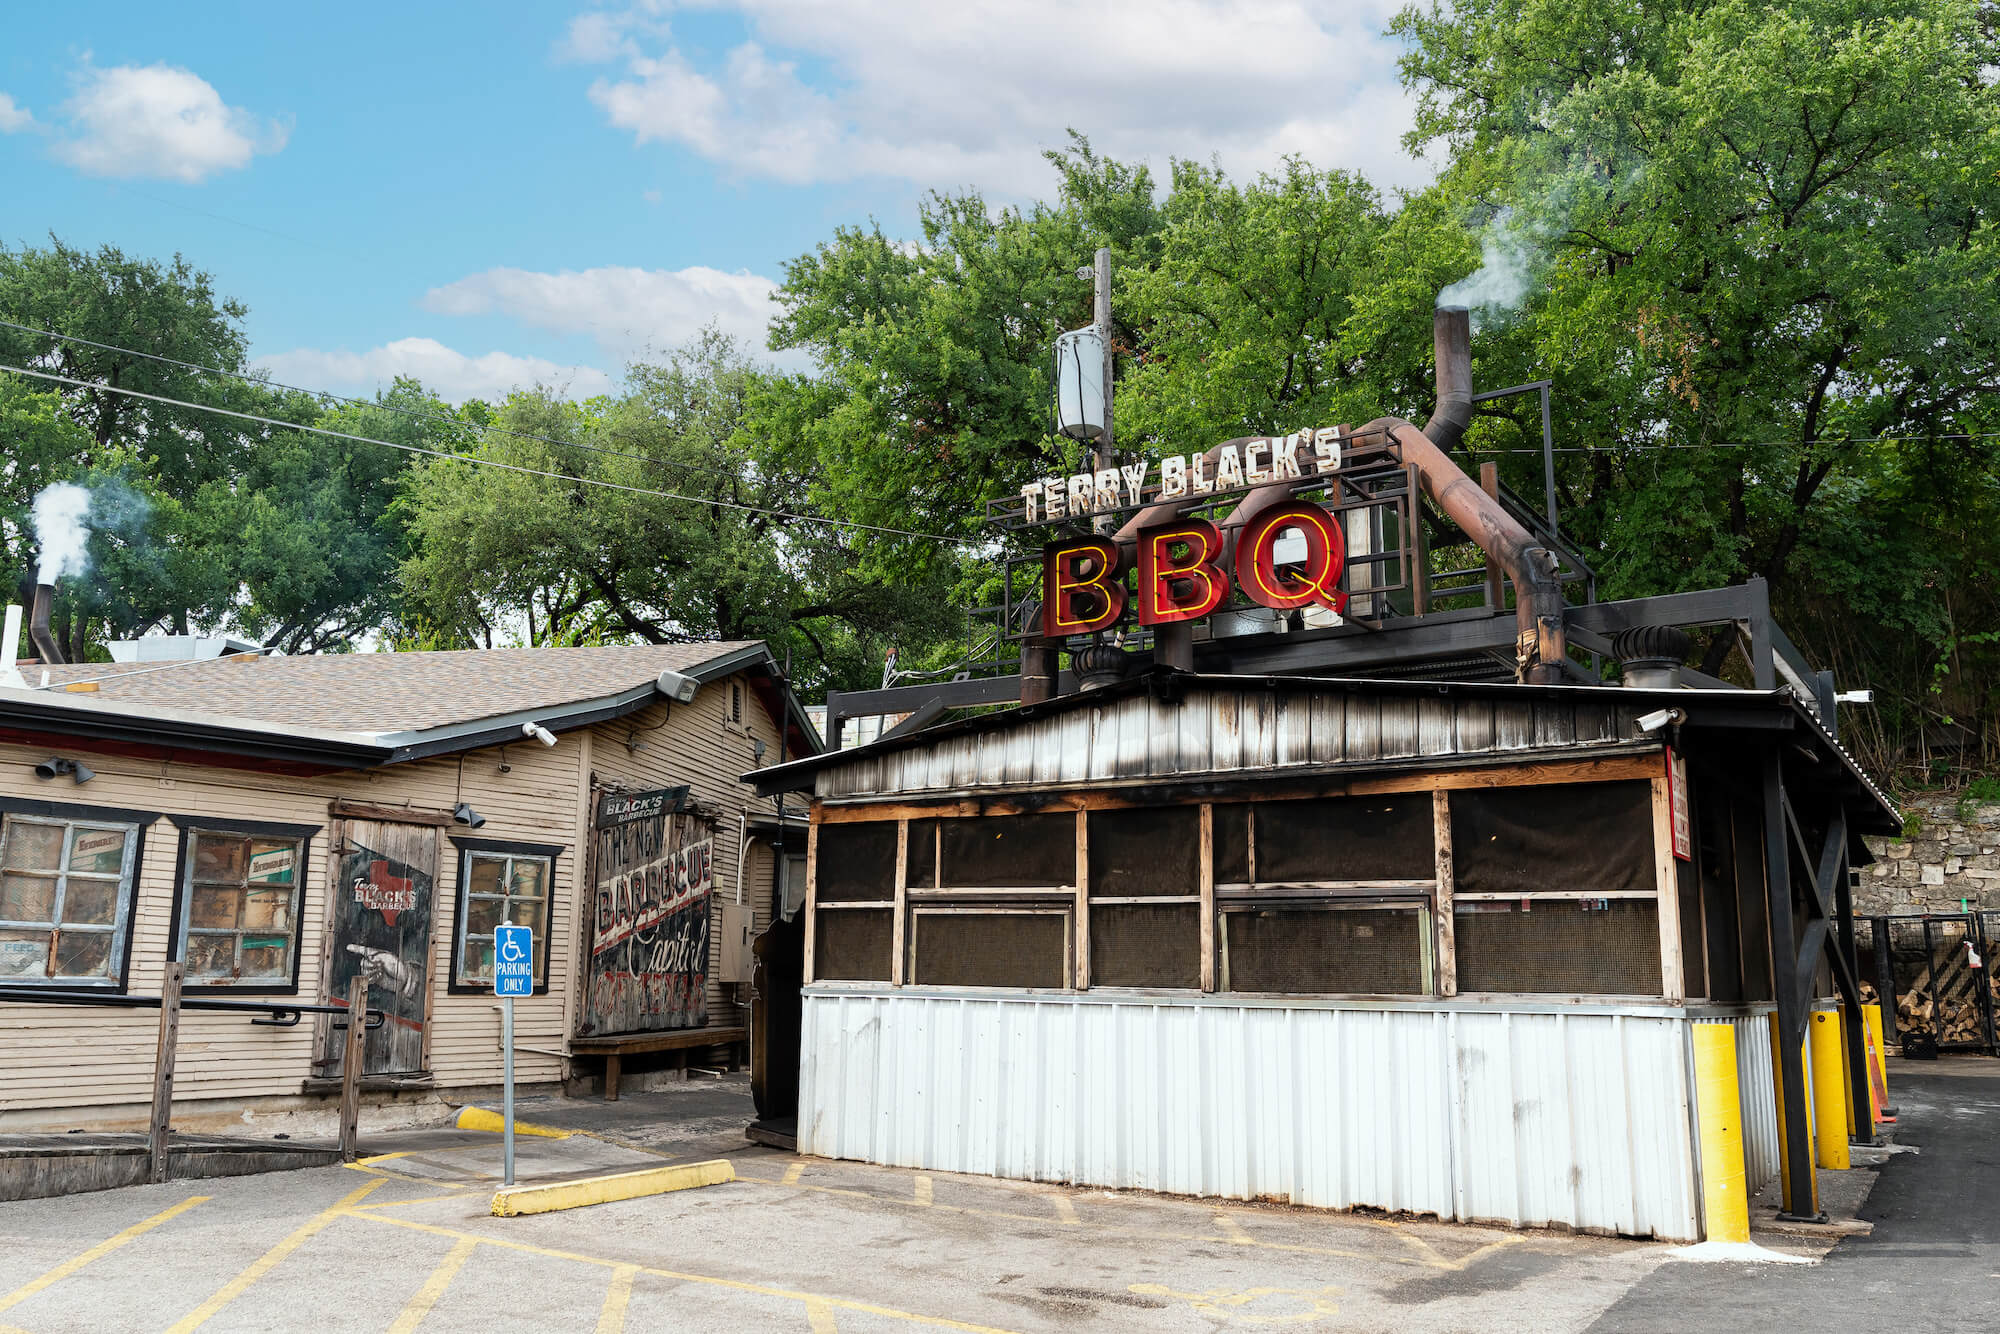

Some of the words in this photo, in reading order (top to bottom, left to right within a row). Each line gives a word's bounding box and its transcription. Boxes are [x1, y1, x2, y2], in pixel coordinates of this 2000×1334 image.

[1021, 462, 1148, 523] TERRY
[1161, 426, 1342, 500] BLACK'S
[1043, 500, 1348, 637] BBQ
[606, 796, 664, 816] BLACK'S
[618, 808, 661, 823] BARBECUE
[602, 822, 630, 870] THE
[354, 890, 417, 902] BLACK'S
[598, 842, 712, 936] BARBECUE
[369, 902, 416, 911] BARBECUE
[497, 962, 531, 976] PARKING
[504, 978, 524, 992] ONLY
